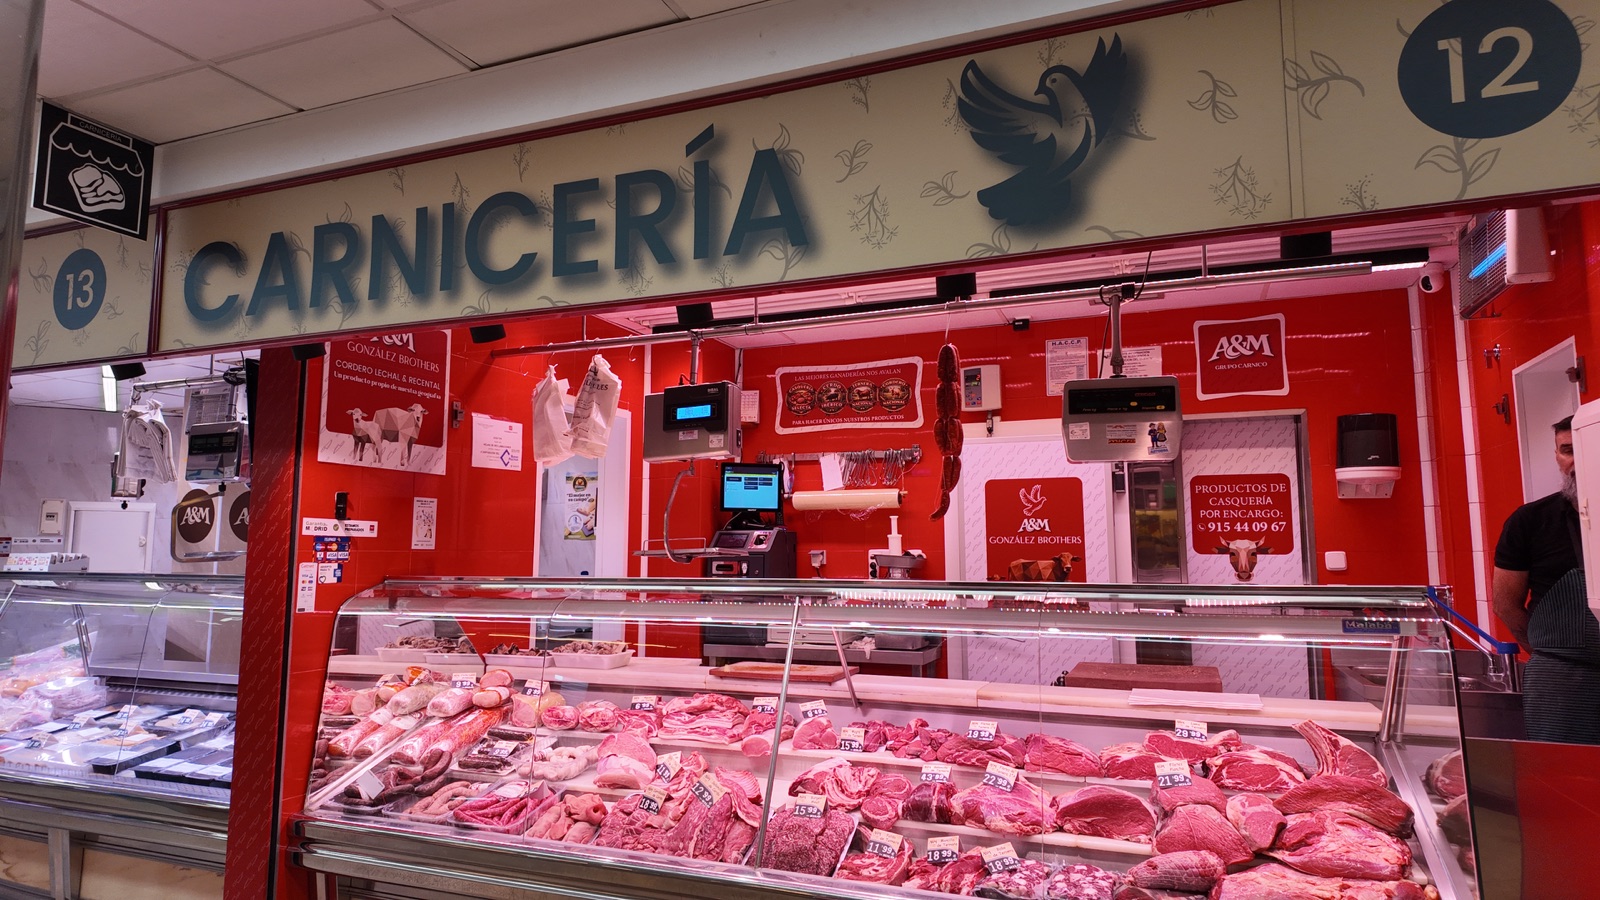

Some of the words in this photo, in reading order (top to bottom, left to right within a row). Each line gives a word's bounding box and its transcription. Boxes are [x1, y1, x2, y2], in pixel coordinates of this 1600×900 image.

[1437, 26, 1539, 103] 12
[183, 123, 810, 322] CARNICERÍA
[66, 268, 96, 310] 13
[347, 341, 396, 362] GONZÁLEZ
[399, 354, 440, 373] BROTHERS
[1208, 334, 1274, 362] A&M
[335, 359, 373, 374] CORDERO
[374, 368, 400, 381] LECHAL
[402, 375, 407, 383] &
[408, 376, 441, 390] RECENTAL
[342, 373, 371, 385] producto
[371, 379, 390, 389] propio
[1195, 484, 1267, 494] PRODUCTOS
[1270, 483, 1287, 492] DE
[1209, 495, 1273, 507] CASQUERÍA
[180, 506, 211, 526] A&M
[1200, 510, 1221, 518] POR
[1223, 509, 1284, 518] ENCARGO:
[1017, 518, 1051, 533] A&M
[1207, 522, 1230, 532] 915
[1234, 522, 1249, 532] 44
[1252, 522, 1268, 532] 09
[1271, 522, 1286, 532] 67
[989, 535, 1035, 544] GONZÁLEZ
[1038, 535, 1082, 544] BROTHERS
